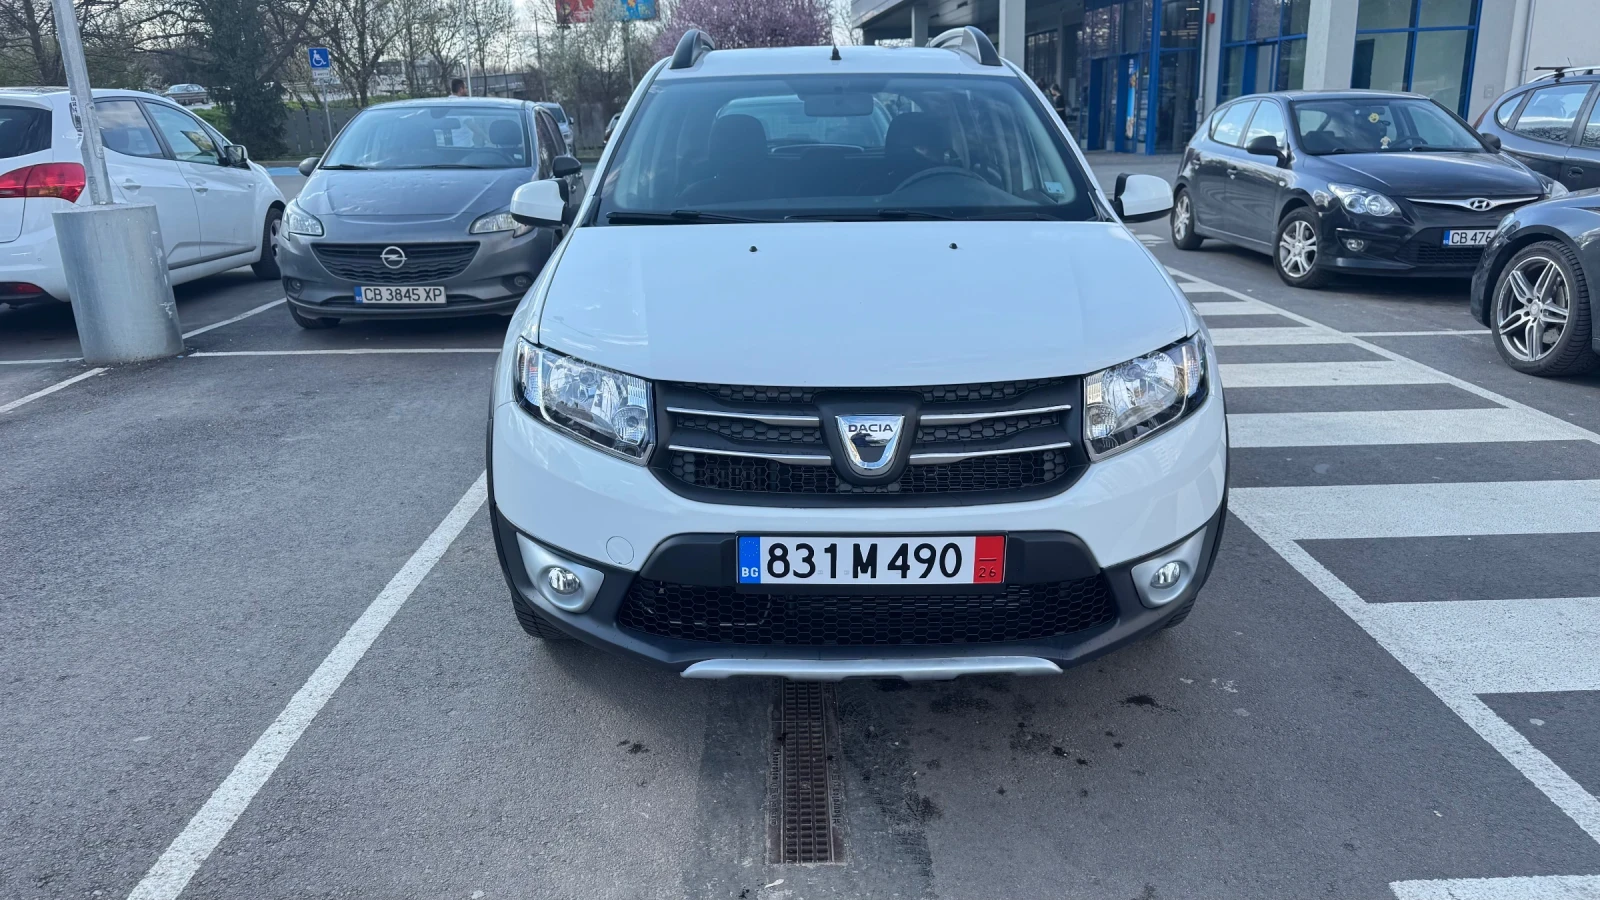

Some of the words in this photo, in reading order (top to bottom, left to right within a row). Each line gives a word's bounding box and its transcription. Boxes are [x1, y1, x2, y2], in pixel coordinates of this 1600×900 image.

[1451, 231, 1467, 244] CB
[364, 288, 382, 301] CB
[386, 288, 420, 302] 3845
[423, 288, 442, 302] XP
[848, 424, 893, 432] DACIA
[767, 542, 838, 579] 831
[852, 543, 878, 579] M
[887, 542, 962, 579] 490
[741, 567, 759, 577] BG
[978, 567, 997, 578] 26
